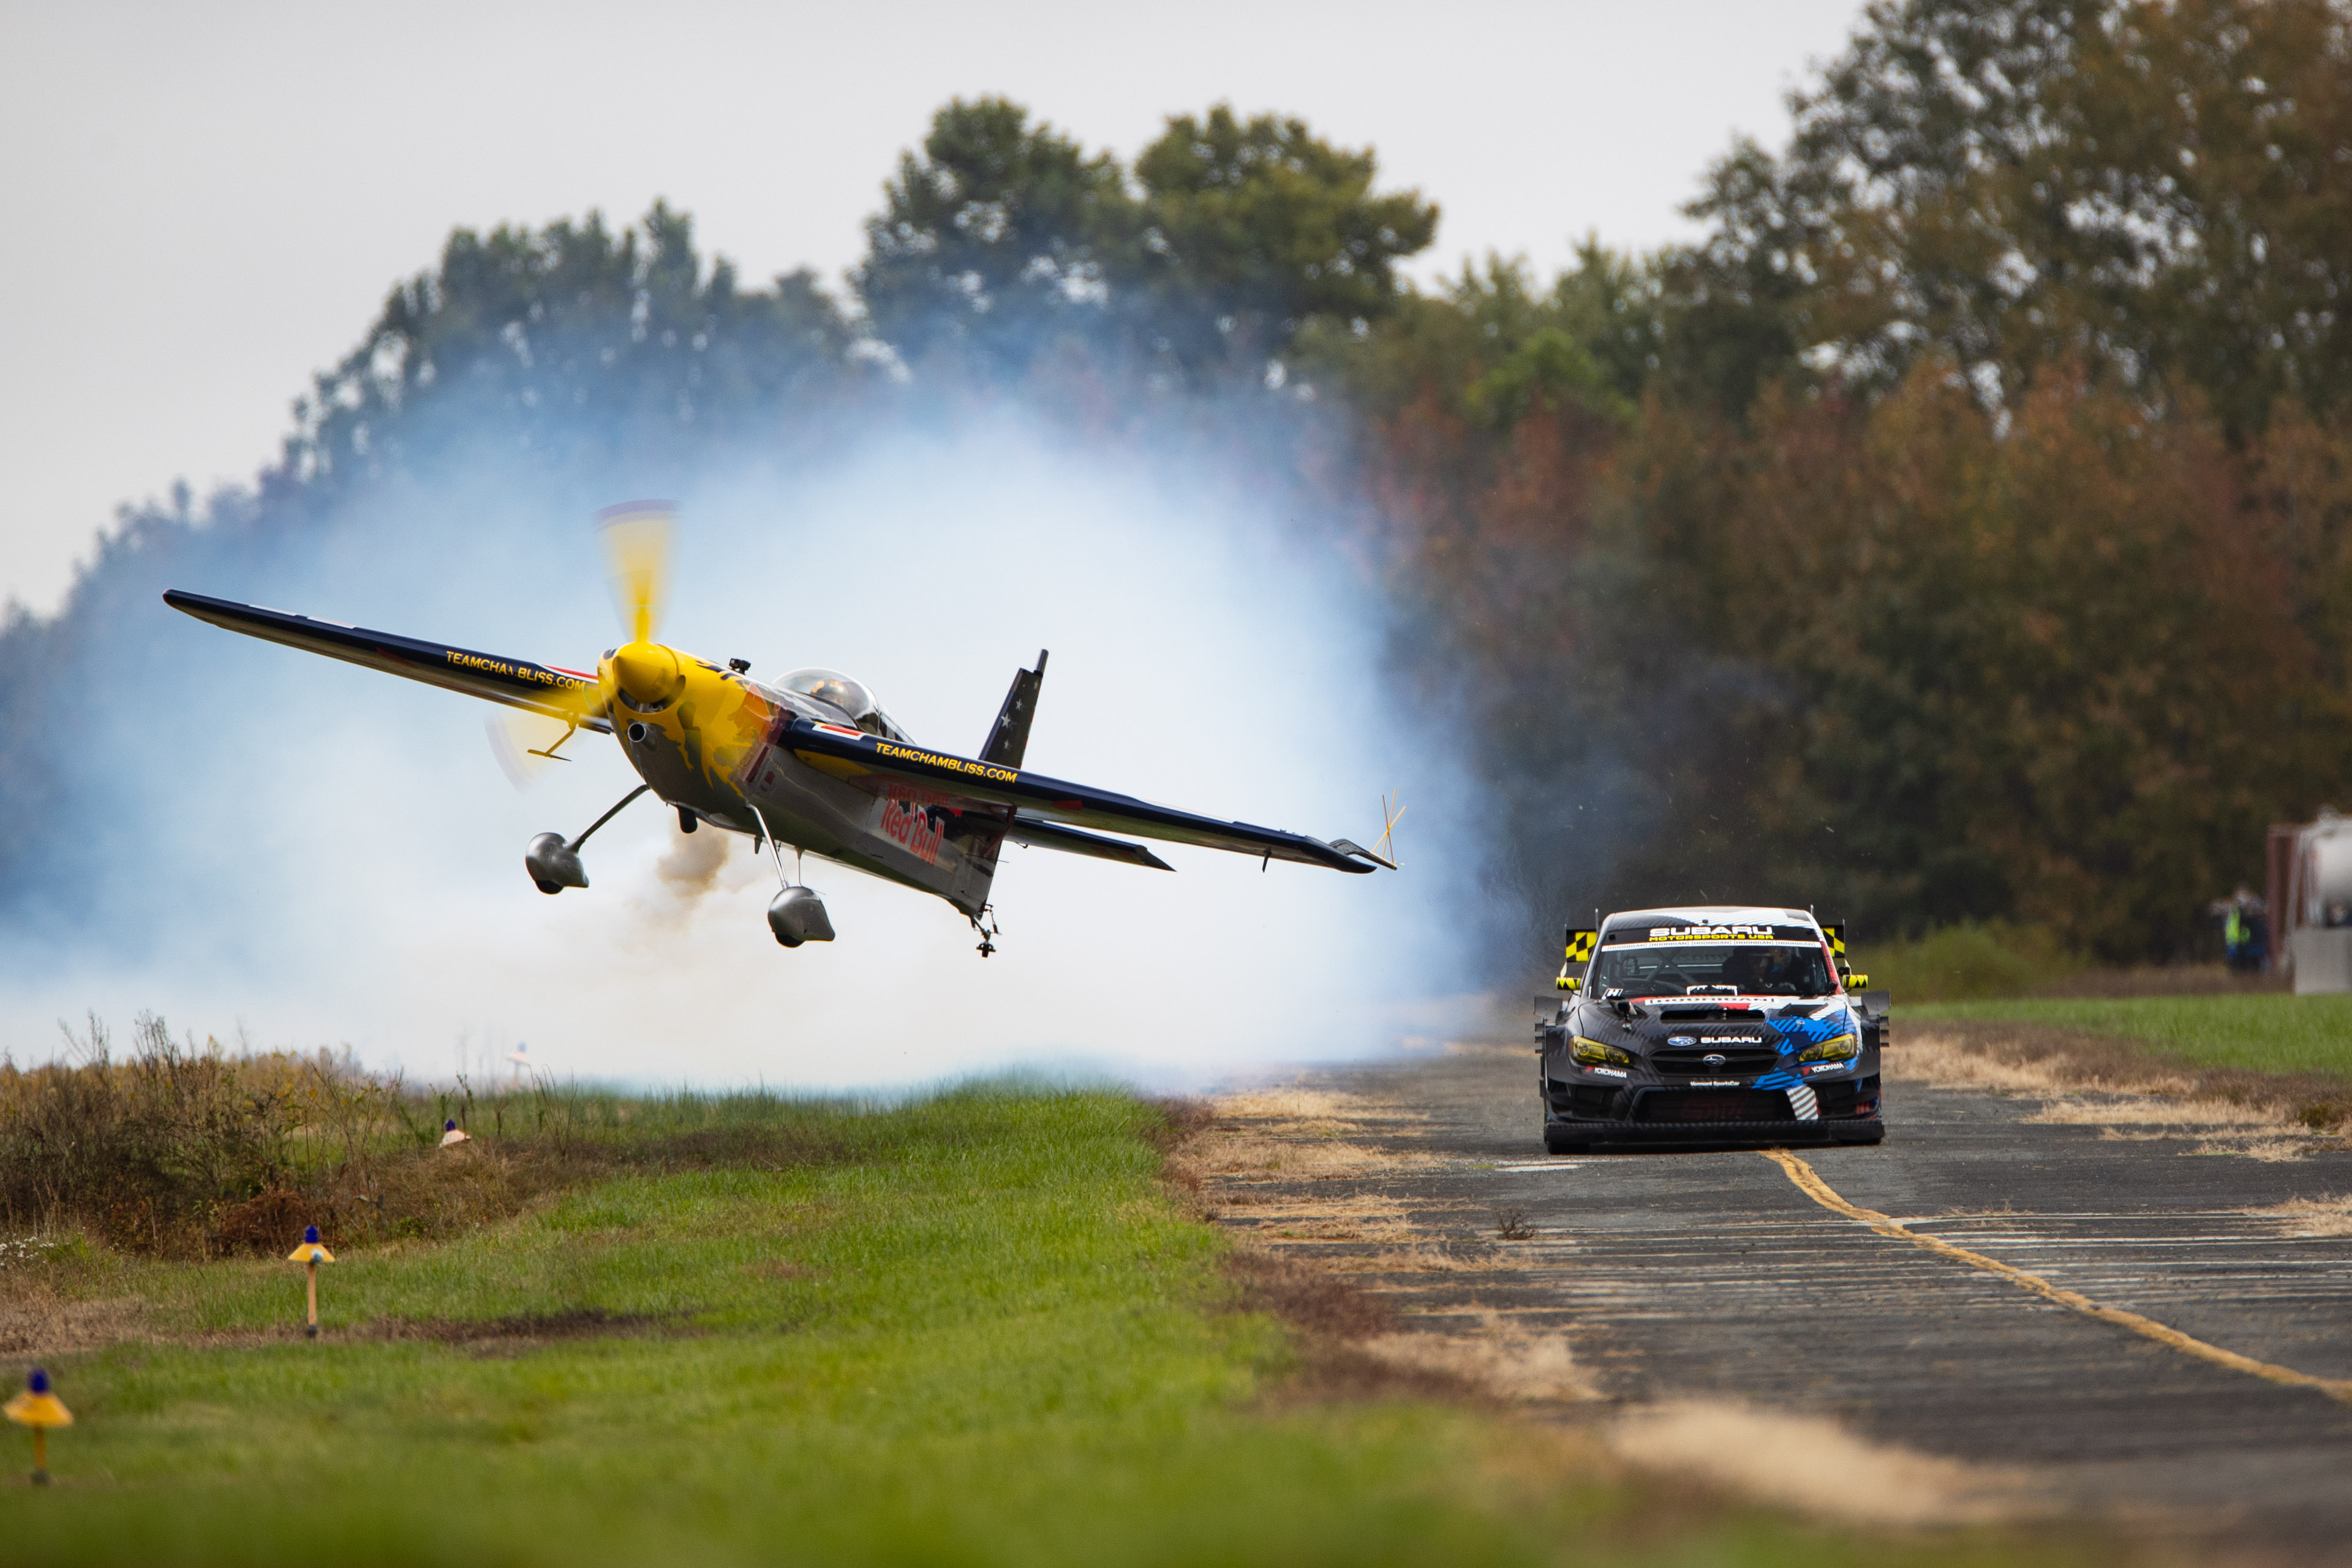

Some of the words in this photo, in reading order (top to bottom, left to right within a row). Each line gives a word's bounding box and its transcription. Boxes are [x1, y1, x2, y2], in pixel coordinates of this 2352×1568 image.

[876, 742, 1018, 783] TEAMCHAMBLISS.COM
[880, 798, 916, 845] Red
[910, 811, 944, 867] Bull
[1649, 926, 1773, 937] SUBARU
[1594, 1066, 1627, 1079] YOKOHAMA
[1811, 1062, 1845, 1073] YOKOHAMA
